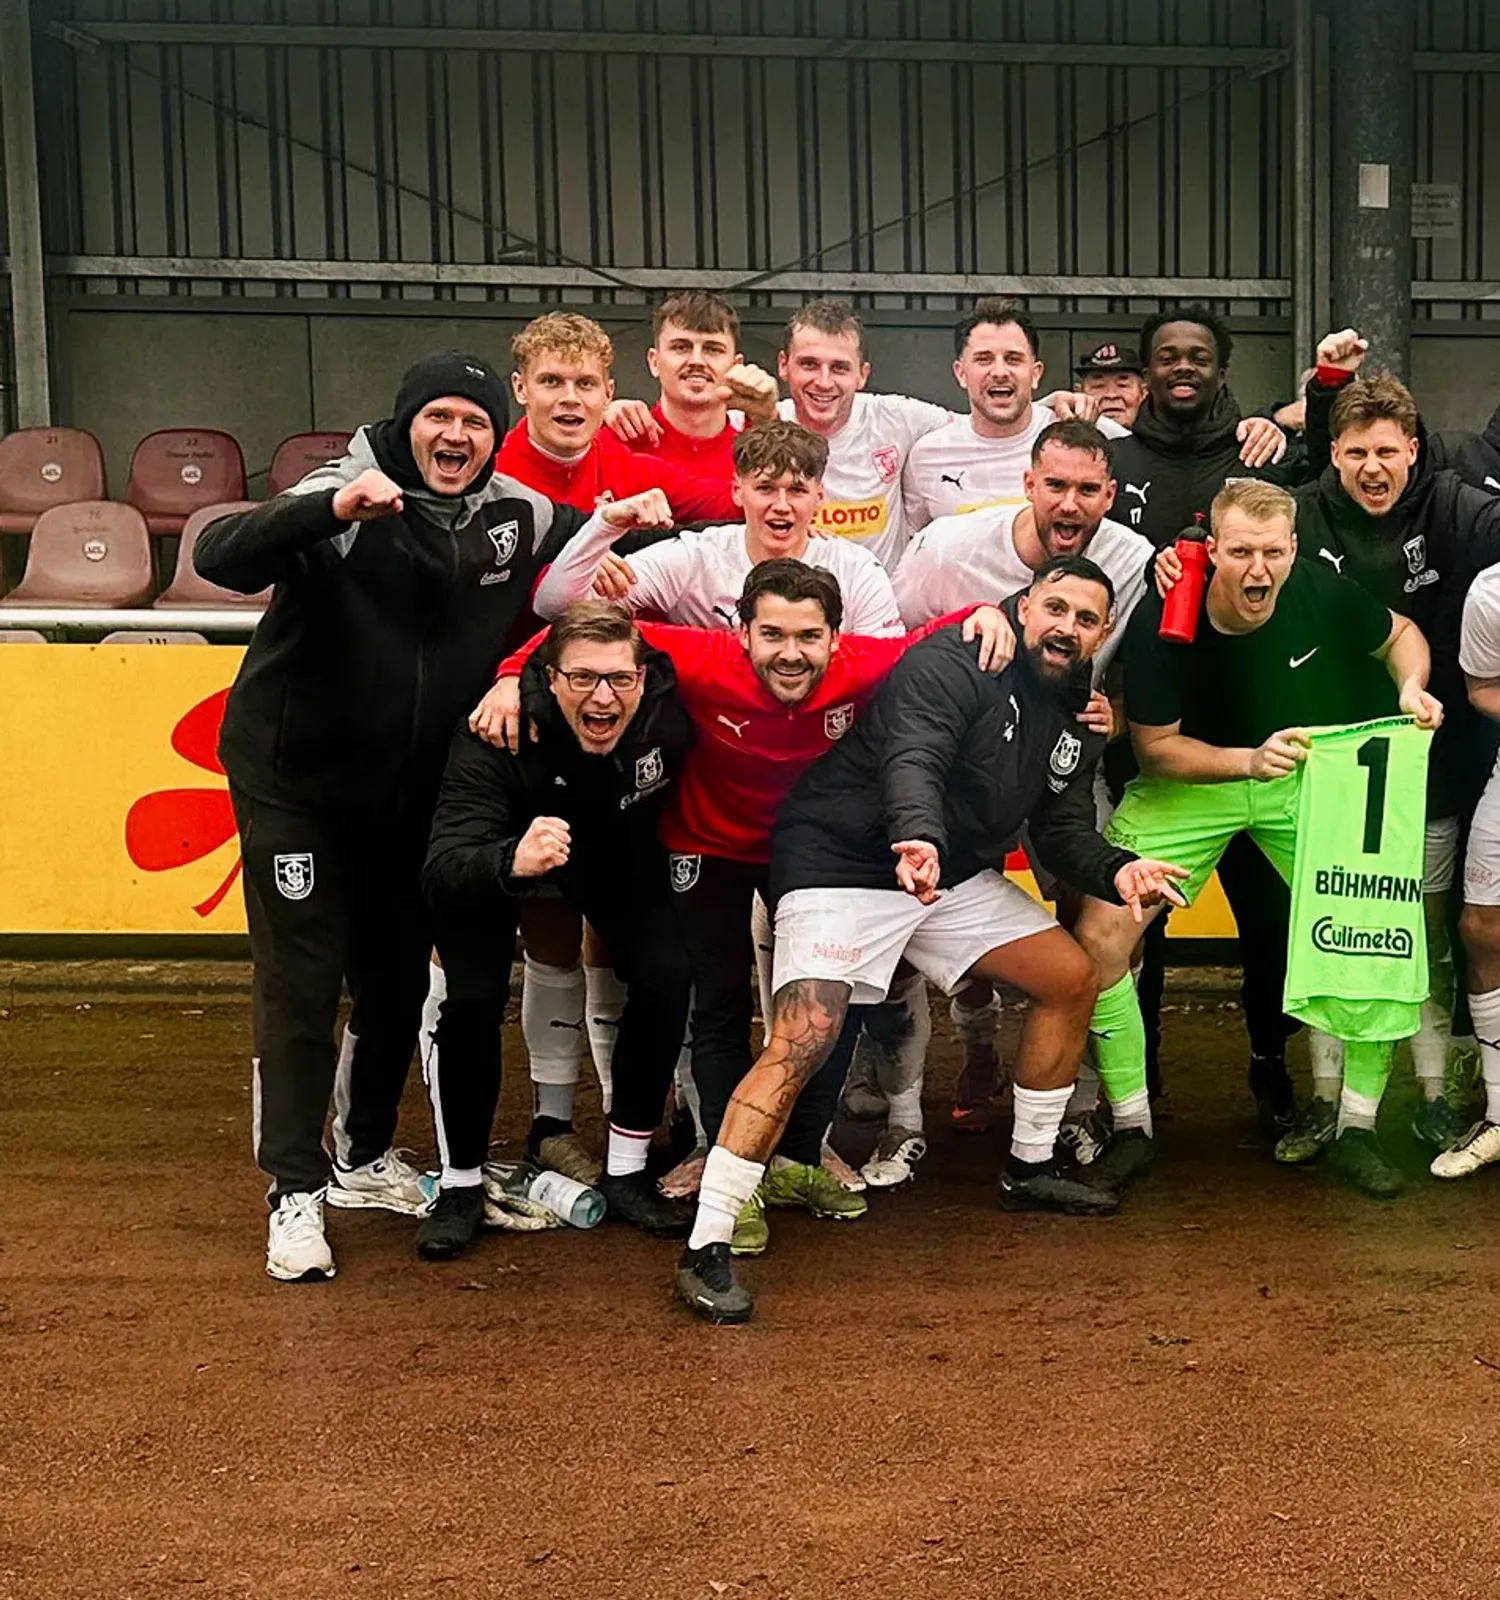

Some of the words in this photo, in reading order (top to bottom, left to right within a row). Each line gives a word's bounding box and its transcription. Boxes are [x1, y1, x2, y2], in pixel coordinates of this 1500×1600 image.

[822, 505, 880, 525] LOTTO
[1358, 736, 1390, 854] 1
[1315, 865, 1422, 903] BÖHMANN
[1313, 917, 1411, 956] Culimeta
